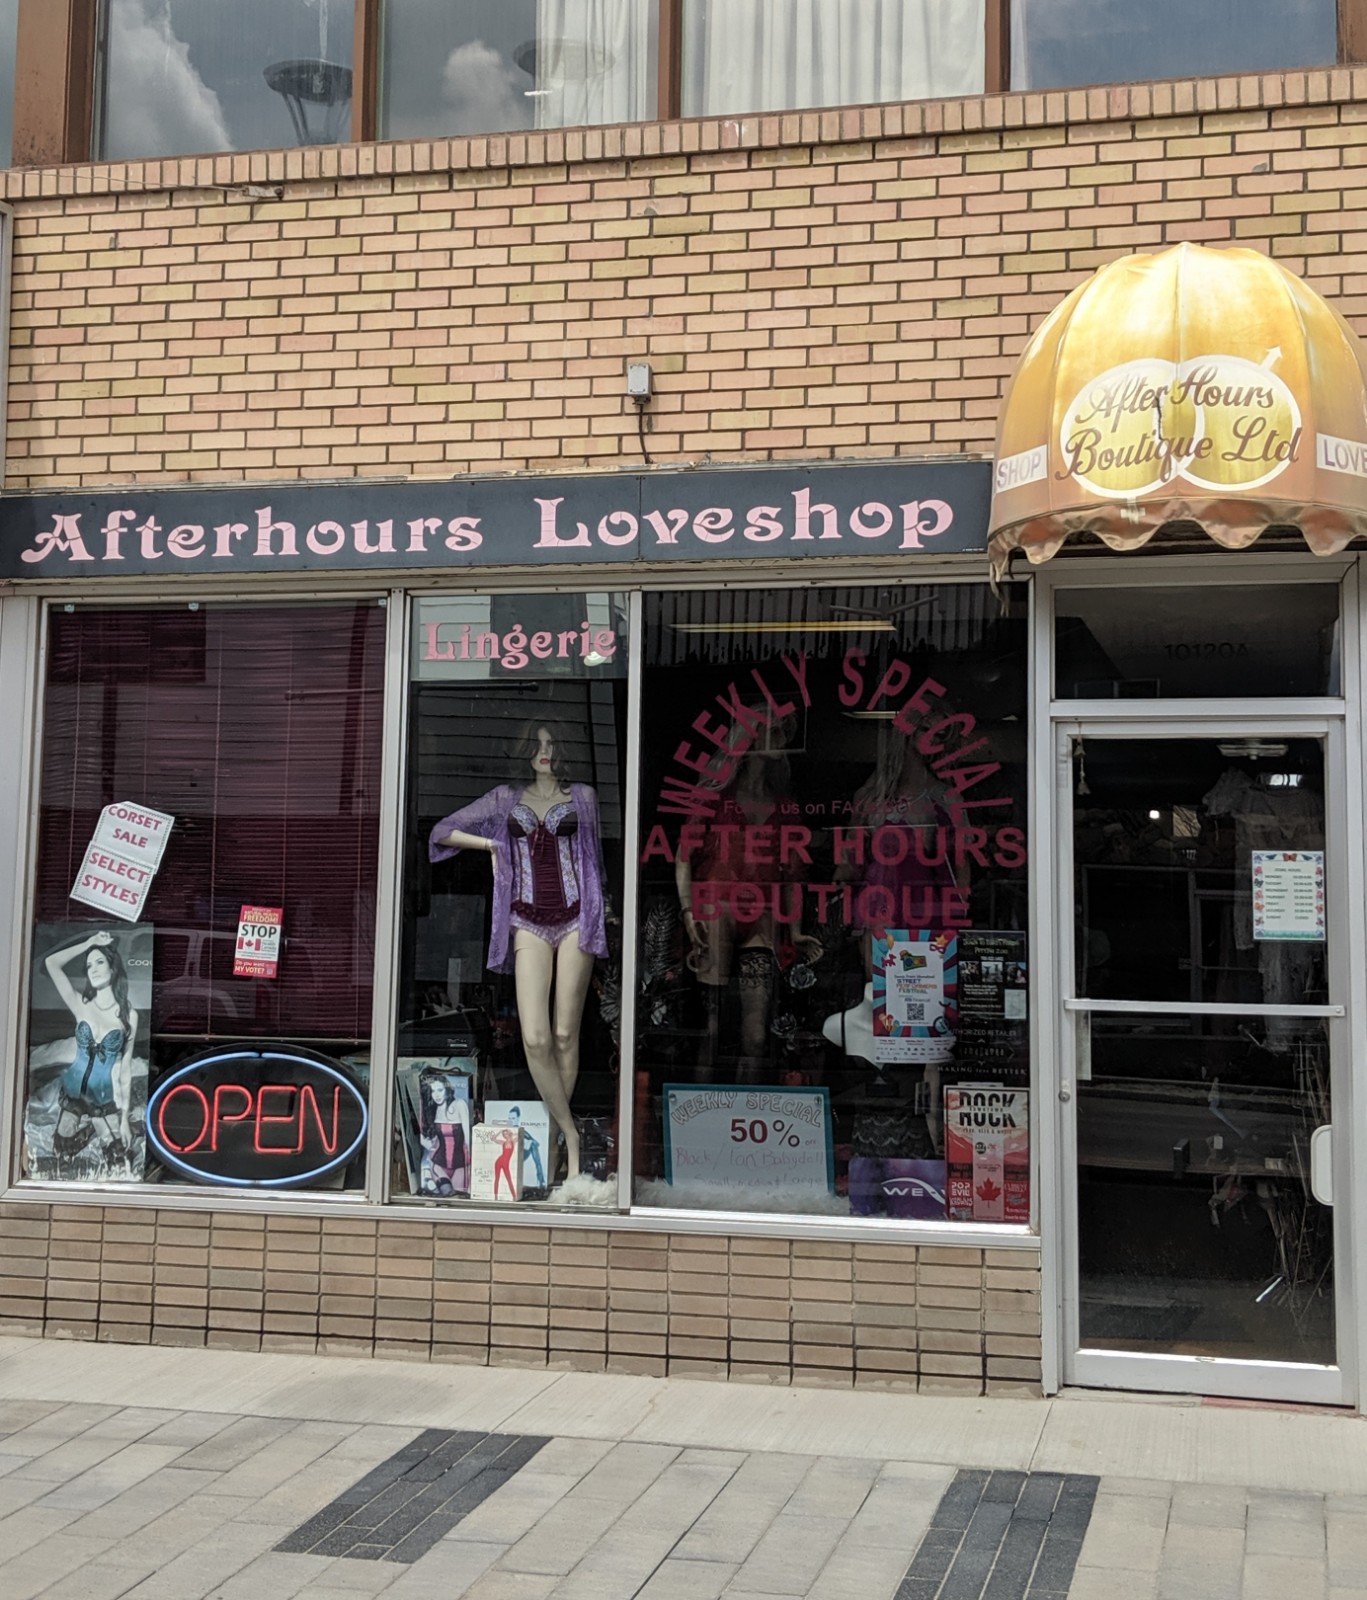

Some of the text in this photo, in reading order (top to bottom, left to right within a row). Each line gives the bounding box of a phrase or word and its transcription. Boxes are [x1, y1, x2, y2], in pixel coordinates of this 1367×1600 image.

[1075, 365, 1274, 433] After Hours
[1055, 415, 1303, 483] Boutique Ltd
[997, 455, 1042, 487] SHOP
[20, 487, 954, 564] Afterhours Loveshop
[424, 621, 617, 669] Lingerie
[1165, 642, 1249, 661] 10120A
[656, 646, 1014, 824] WEEKLY SPECIAL
[108, 805, 162, 831] CORSET
[781, 803, 800, 814] us
[805, 803, 826, 814] on
[112, 828, 148, 848] SALE
[640, 824, 1028, 869] AFTER HOURS
[89, 852, 149, 883] SELECT
[81, 874, 140, 905] STYLES
[691, 881, 972, 928] BOUTIQUE
[241, 924, 277, 938] STOP
[245, 966, 265, 975] VOTE?
[158, 1084, 341, 1154] OPEN
[671, 1091, 822, 1128] WEEKLY SPECIAL
